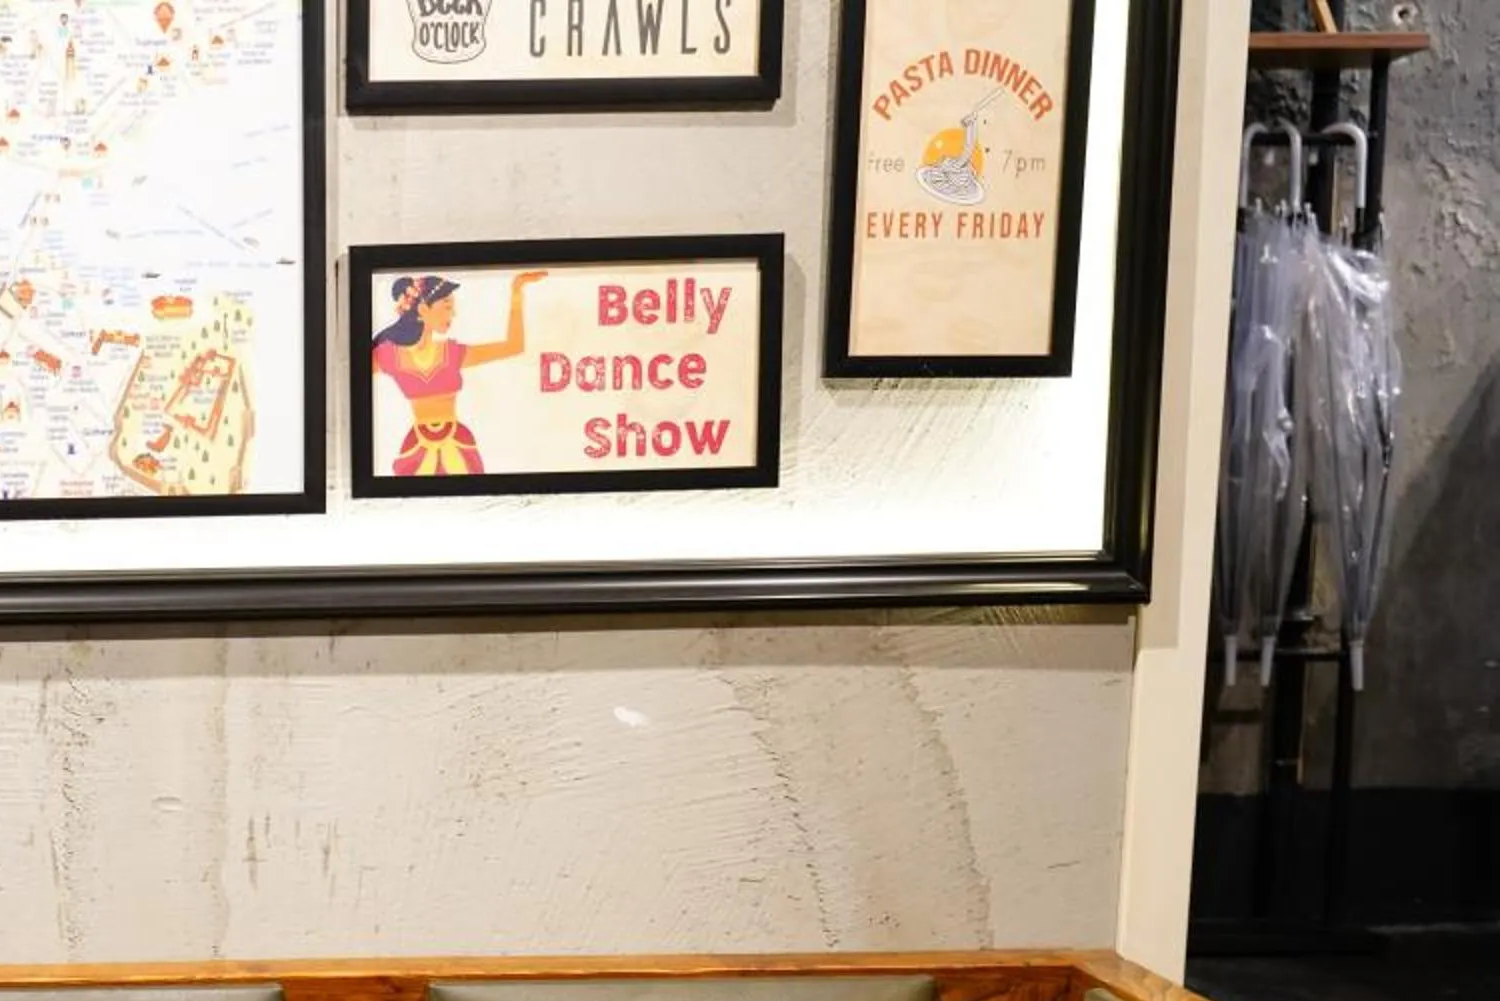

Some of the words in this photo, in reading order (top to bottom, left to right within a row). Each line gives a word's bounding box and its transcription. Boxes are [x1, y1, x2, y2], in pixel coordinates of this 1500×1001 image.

[530, 0, 731, 57] CRAWLS
[873, 51, 954, 121] PASTA
[963, 48, 1054, 121] DINNER
[867, 211, 943, 239] EVERY
[956, 211, 1045, 239] FRIDAY
[598, 278, 733, 335] Belly
[539, 351, 707, 393] Dance
